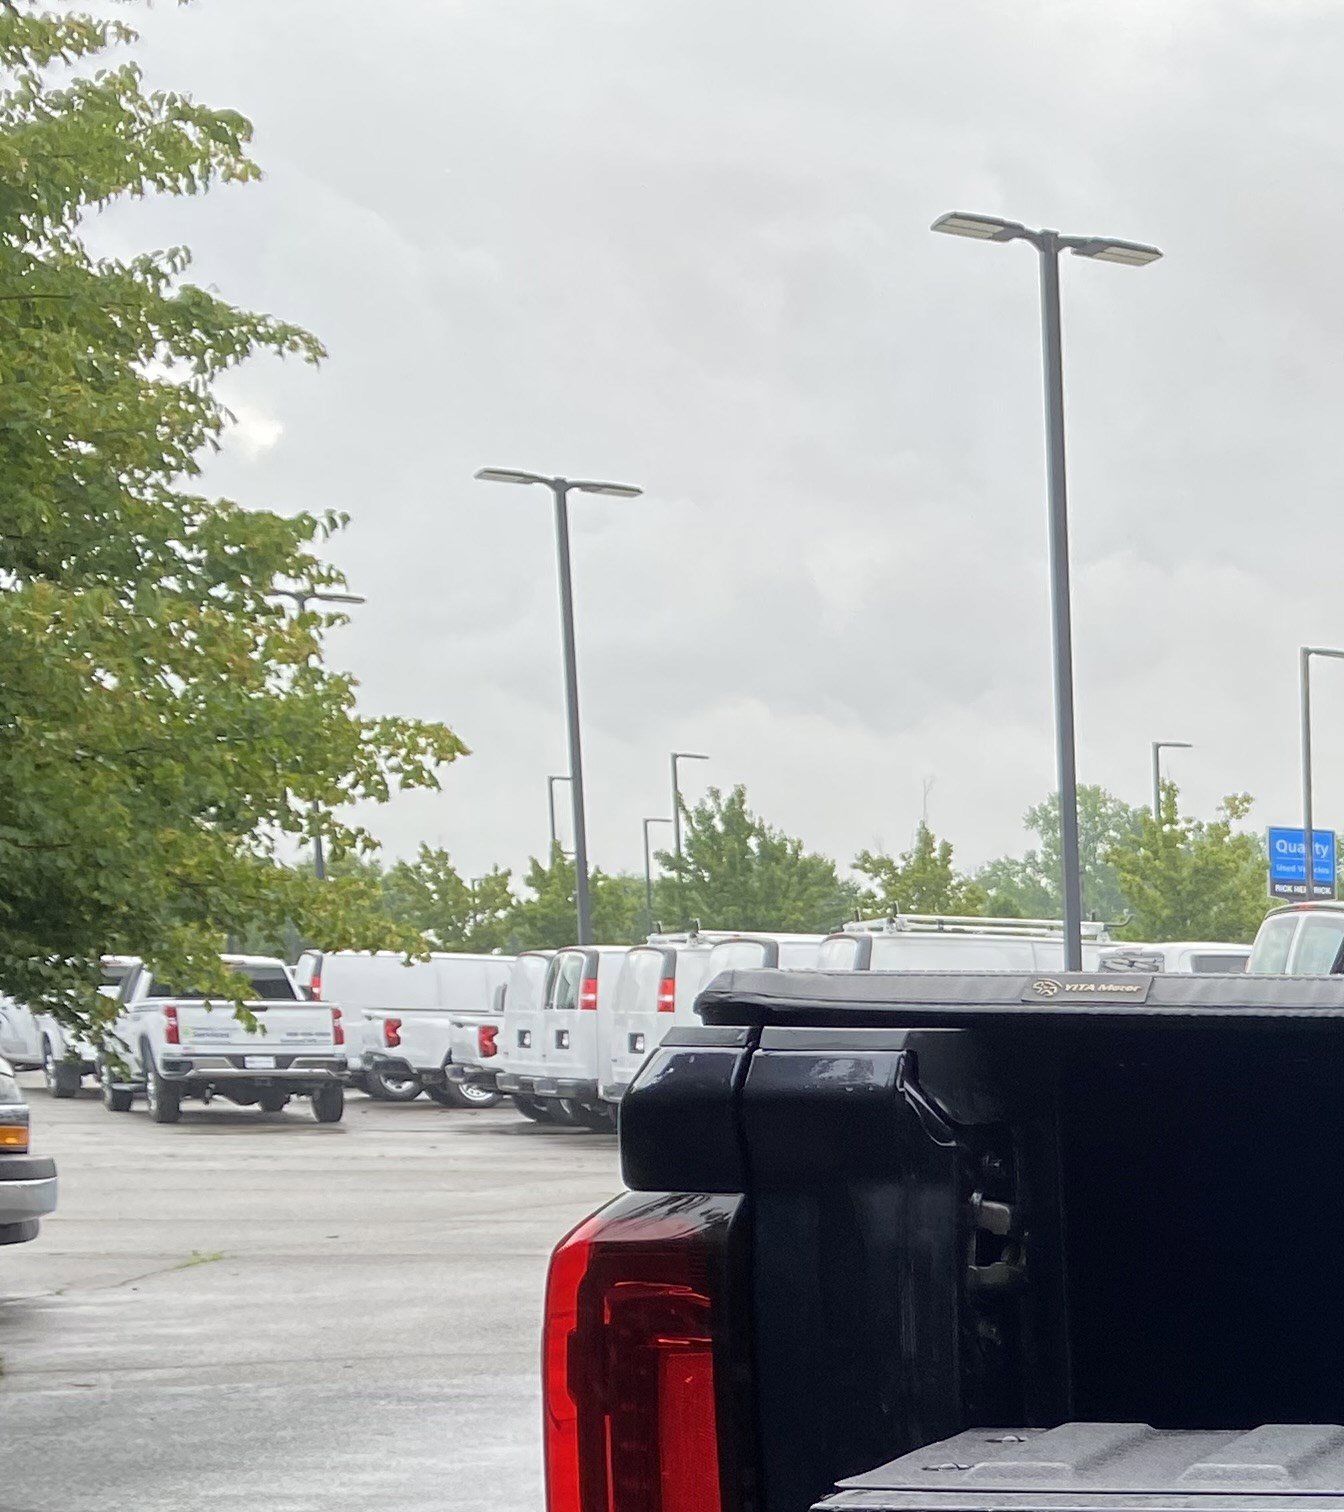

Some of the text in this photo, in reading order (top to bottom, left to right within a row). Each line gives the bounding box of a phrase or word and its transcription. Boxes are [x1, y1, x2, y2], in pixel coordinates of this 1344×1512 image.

[1276, 839, 1329, 858] Quaty
[1297, 865, 1330, 874] Vecles
[1275, 884, 1331, 894] RICK HENRICK
